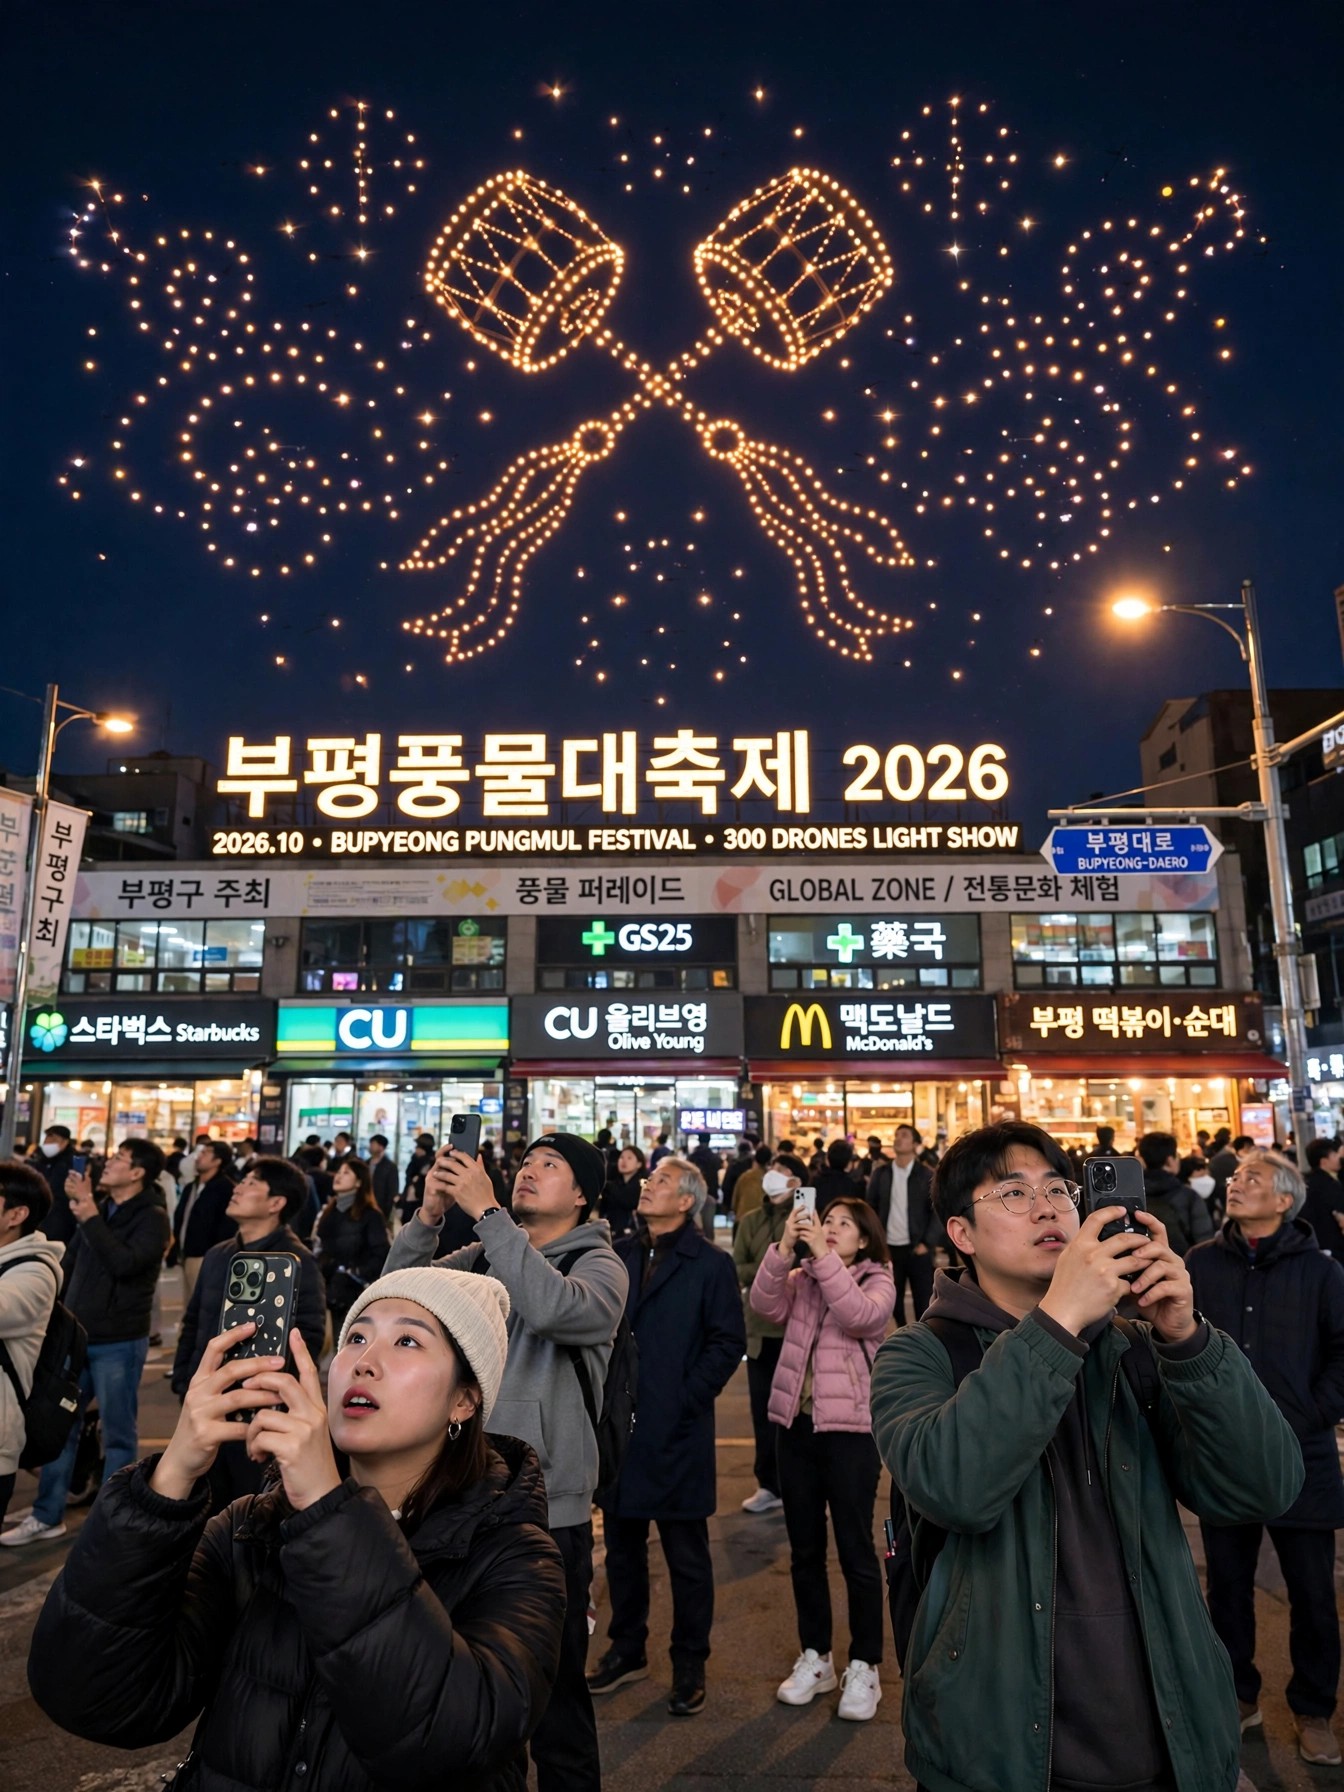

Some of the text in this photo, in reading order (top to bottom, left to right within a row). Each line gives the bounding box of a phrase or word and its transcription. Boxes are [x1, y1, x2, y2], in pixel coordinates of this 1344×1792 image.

[217, 731, 1009, 819] 부평풍물대축제 2026
[212, 831, 304, 854] 2026.10
[330, 830, 460, 854] BUPYEONG
[465, 829, 583, 852] PUNGMUL
[588, 828, 697, 851] FESTIVAL
[723, 827, 767, 850] 300
[772, 827, 868, 850] DRONES
[873, 826, 943, 849] LIGHT
[946, 826, 1019, 849] SHOW
[1086, 831, 1175, 855] 부평대로
[1077, 855, 1189, 870] BUPYEONG-DAERO
[117, 878, 271, 910] 부평구 주최
[515, 875, 686, 905] 풍물 퍼레이드
[768, 877, 864, 902] GLOBAL
[871, 876, 936, 902] ZONE
[963, 874, 1063, 903] 전통문화
[1070, 874, 1120, 902] 체험
[618, 923, 693, 952] GS25
[870, 921, 947, 960] 藥국
[69, 1013, 260, 1046] 스타벅스 Starbucks
[339, 1008, 407, 1049] CU
[544, 1002, 707, 1040] CU 올리브영
[839, 1003, 955, 1036] 맥도날드
[1030, 1005, 1084, 1039] 부평
[608, 1032, 705, 1054] Olive Young
[846, 1035, 934, 1052] McDonald's
